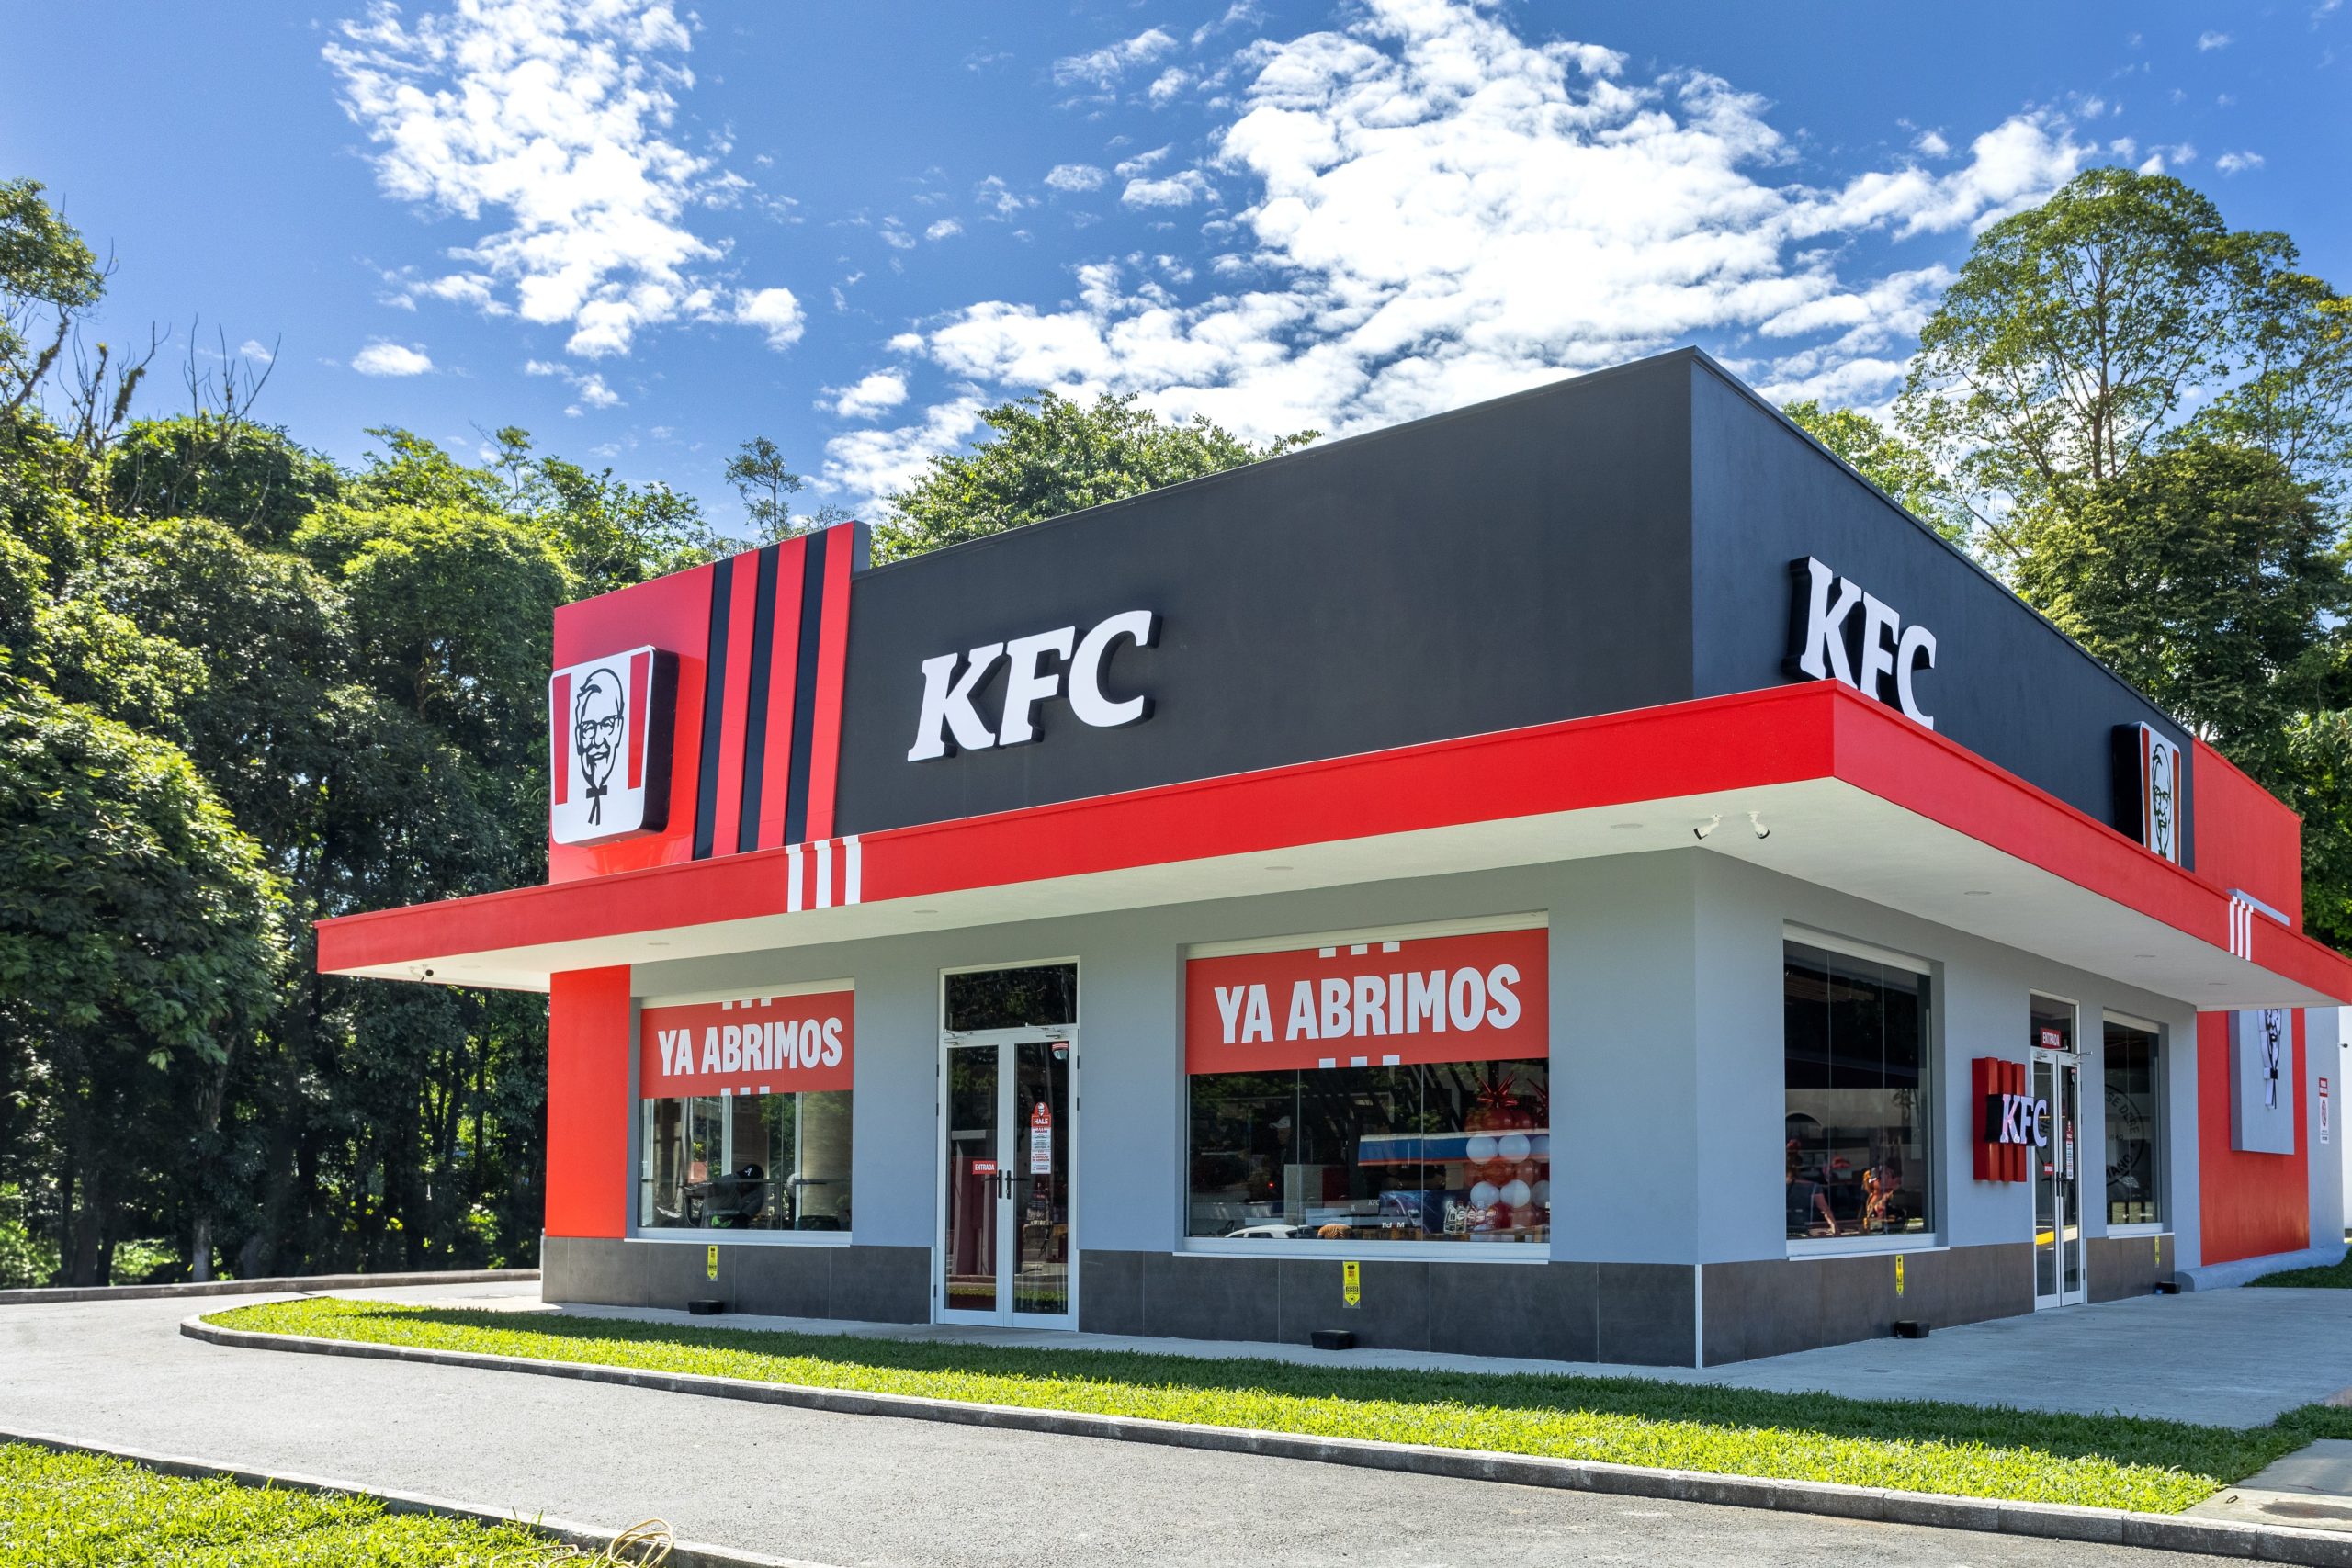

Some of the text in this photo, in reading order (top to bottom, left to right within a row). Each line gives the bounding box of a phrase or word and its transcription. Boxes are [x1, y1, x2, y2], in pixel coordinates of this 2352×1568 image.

[1801, 556, 1937, 731] KFC
[907, 610, 1152, 762] KFC
[1214, 964, 1521, 1044] YA ABRIMOS
[2042, 1032, 2060, 1046] ENTRADA
[657, 1017, 842, 1077] YA ABRIMOS
[1999, 1093, 2048, 1147] KFC
